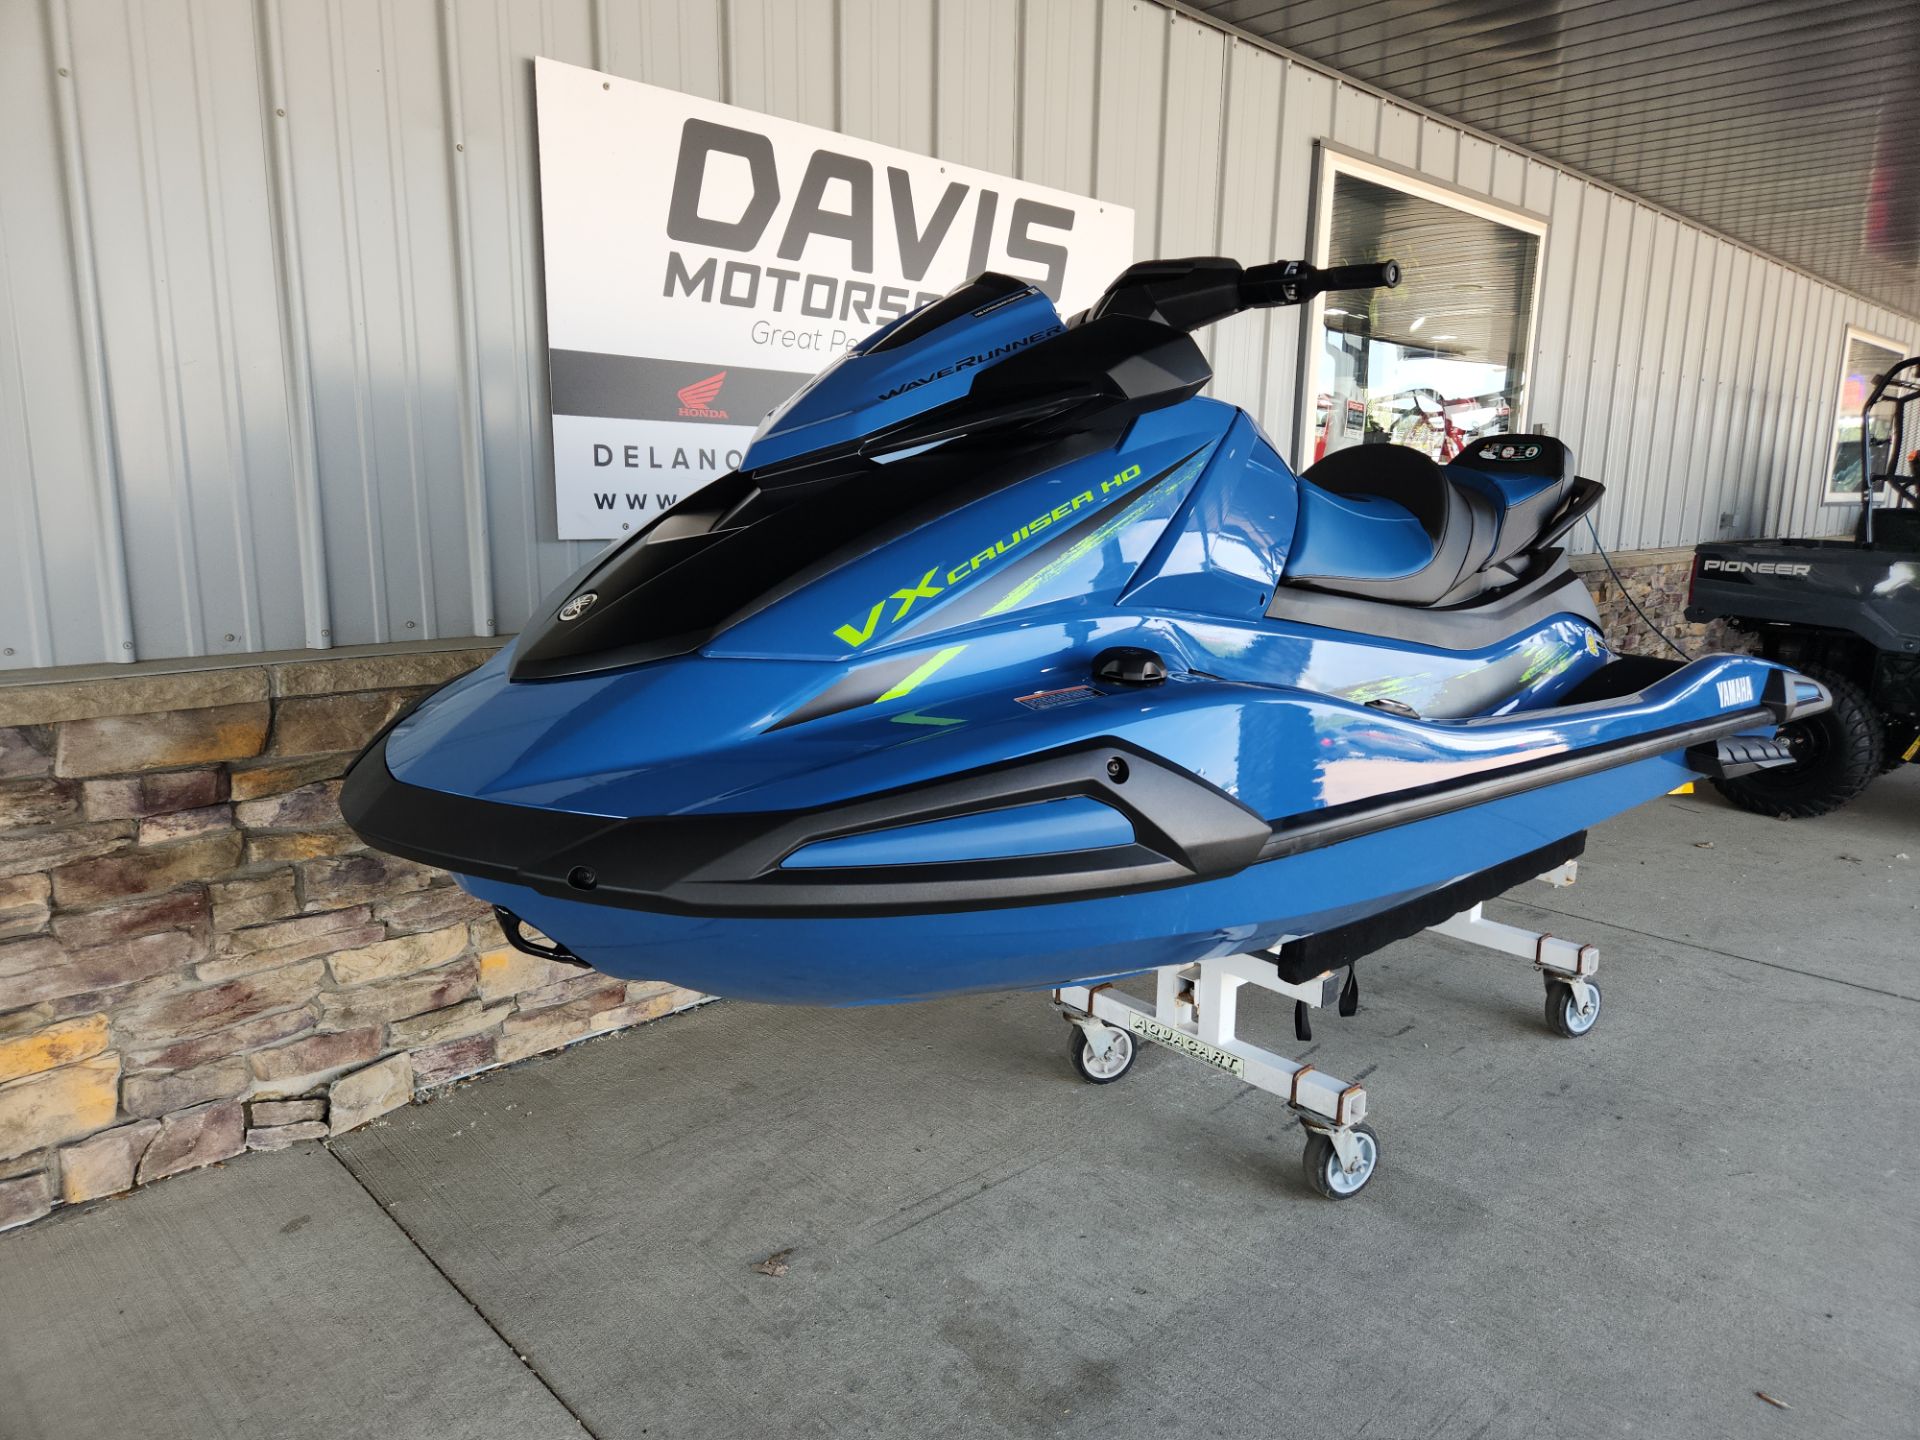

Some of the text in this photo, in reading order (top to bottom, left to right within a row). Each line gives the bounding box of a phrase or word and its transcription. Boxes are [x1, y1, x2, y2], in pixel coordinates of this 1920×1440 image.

[666, 117, 1075, 304] DAVIS
[751, 320, 823, 351] Great
[678, 407, 729, 420] HONDA
[593, 443, 743, 470] DELANO
[833, 464, 1142, 648] VX CRUISER HO
[1703, 559, 1811, 577] PIONEER
[1715, 675, 1753, 709] YAMAHA
[1134, 1019, 1239, 1069] AQUACART
